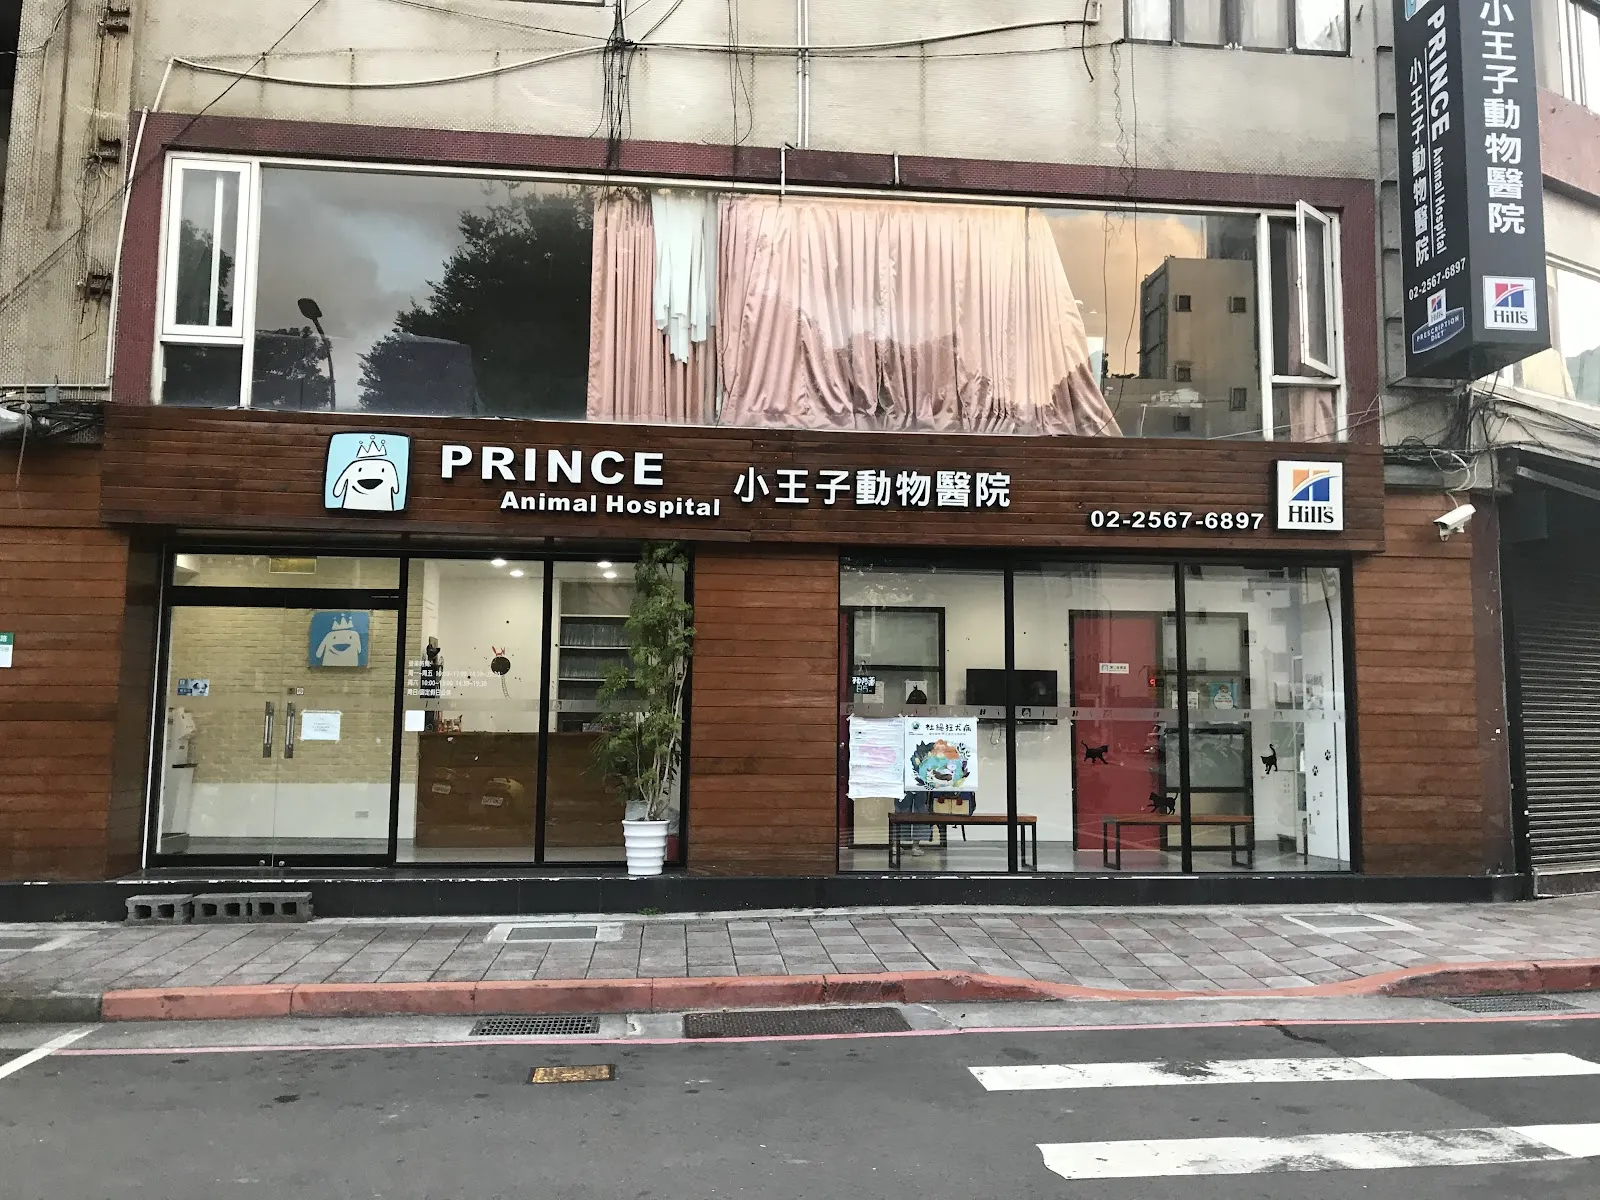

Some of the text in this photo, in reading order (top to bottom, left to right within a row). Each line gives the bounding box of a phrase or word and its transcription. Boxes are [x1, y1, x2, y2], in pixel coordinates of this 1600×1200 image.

[1427, 4, 1451, 255] PRINCE Animal Hospital
[1479, 0, 1526, 236] 小王子動物醫院
[1408, 56, 1430, 268] 小王子動物醫院
[1408, 257, 1467, 301] 02-2567-6897
[1416, 315, 1460, 342] PRESCRIPTION
[1430, 330, 1445, 342] DIET
[441, 444, 664, 486] PRINCE
[500, 491, 721, 518] Animal Hospital
[733, 467, 1011, 508] 小王子動物醫院
[1090, 510, 1265, 531] 02-2567-6897
[1288, 505, 1334, 524] Hill's
